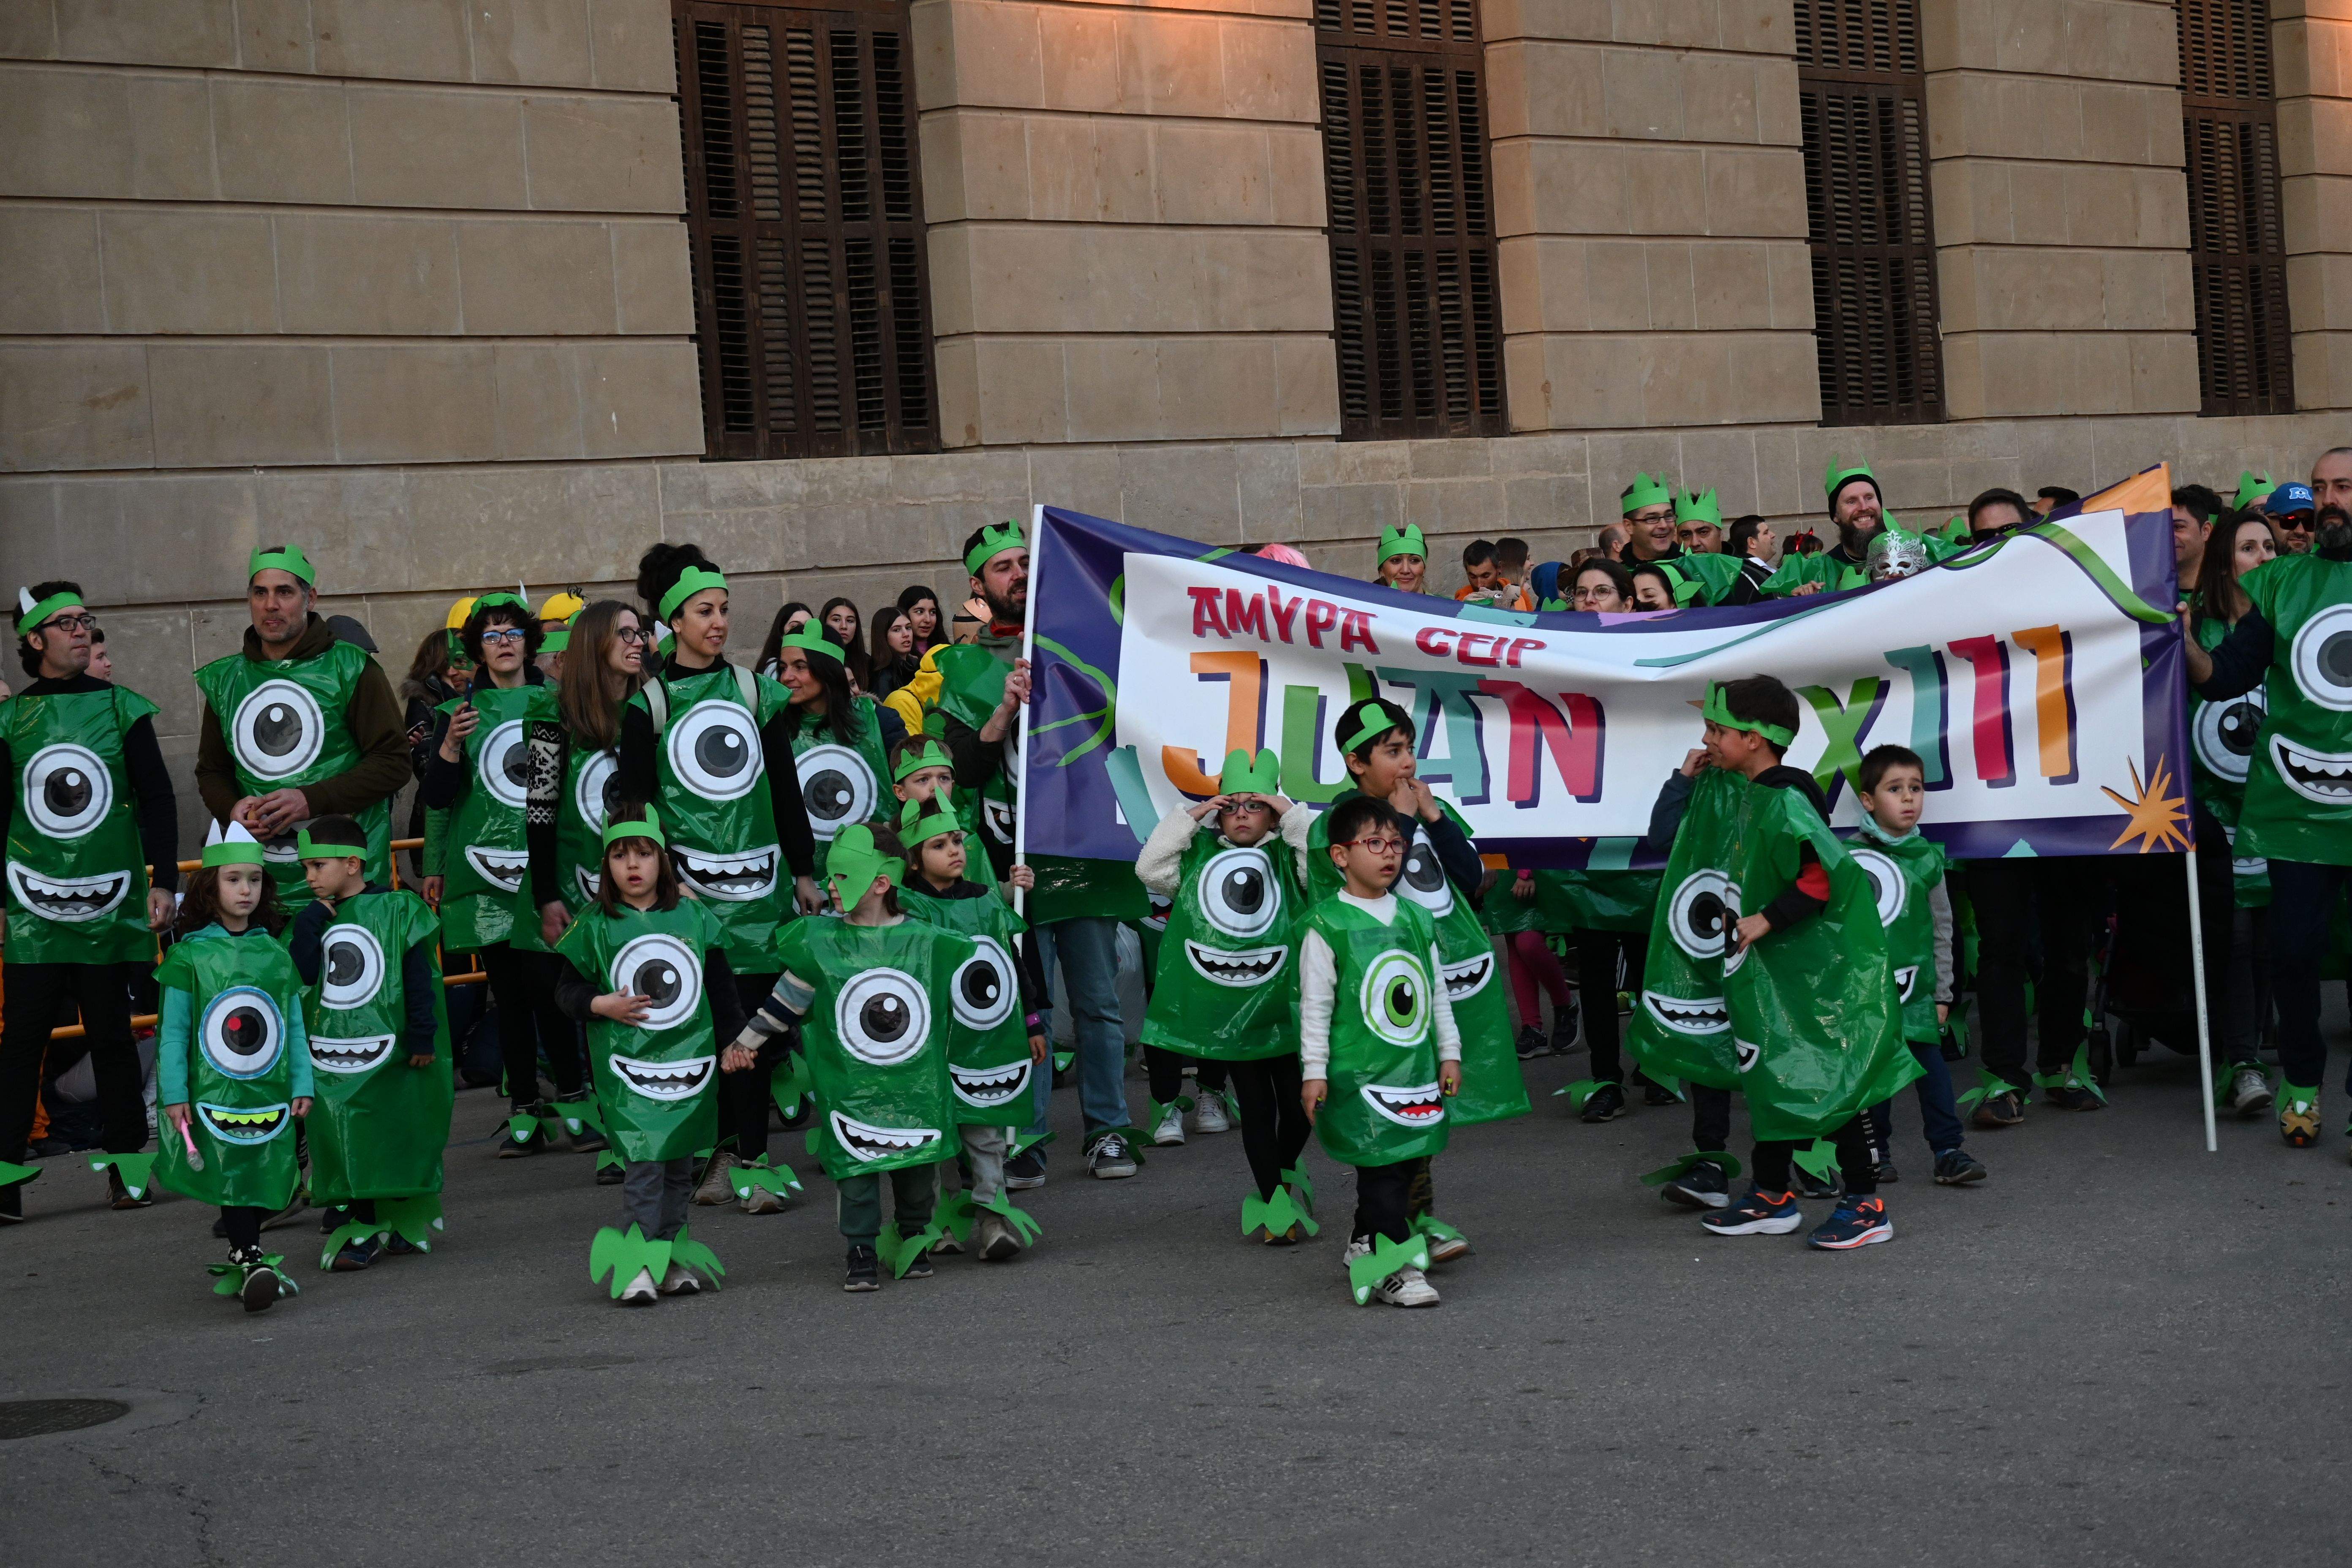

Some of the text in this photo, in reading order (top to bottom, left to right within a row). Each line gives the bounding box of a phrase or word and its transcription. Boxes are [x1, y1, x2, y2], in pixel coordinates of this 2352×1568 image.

[1187, 585, 1547, 668] AMYPA CEIP
[1162, 624, 2078, 814] JUAN XIII
